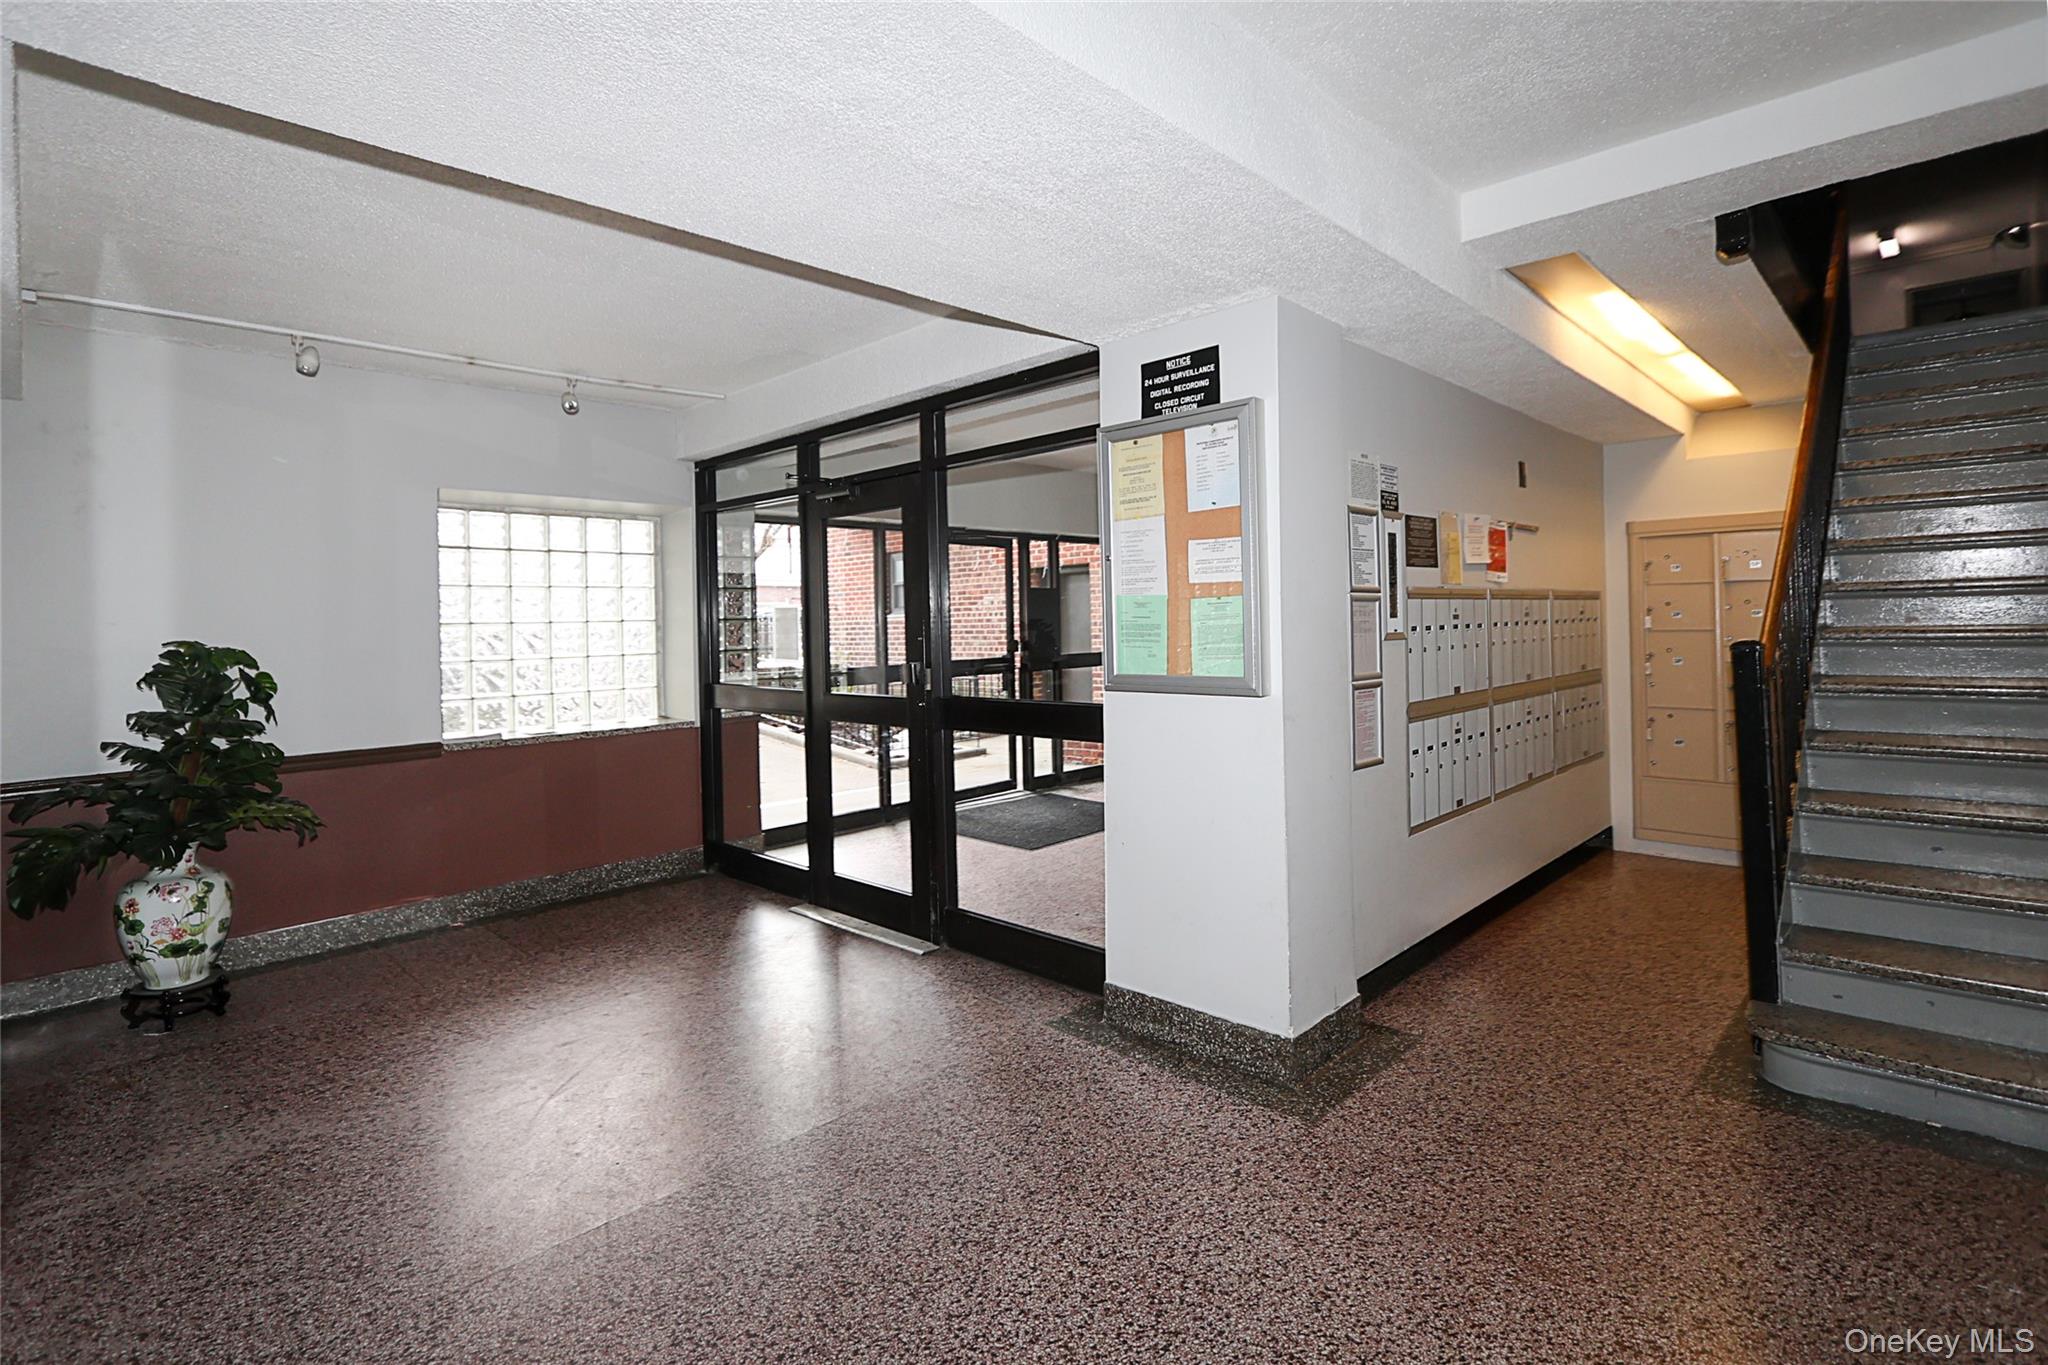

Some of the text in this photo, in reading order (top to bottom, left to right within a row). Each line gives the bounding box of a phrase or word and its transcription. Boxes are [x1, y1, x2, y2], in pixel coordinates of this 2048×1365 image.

[1166, 355, 1191, 370] NOTICE
[1144, 363, 1215, 387] 24 HOUR SURVEILLANCE
[1150, 378, 1209, 398] DIGITAL RECORDING
[1154, 393, 1205, 410] CLOSED CIRCUIT
[1162, 403, 1198, 416] TELEVISION
